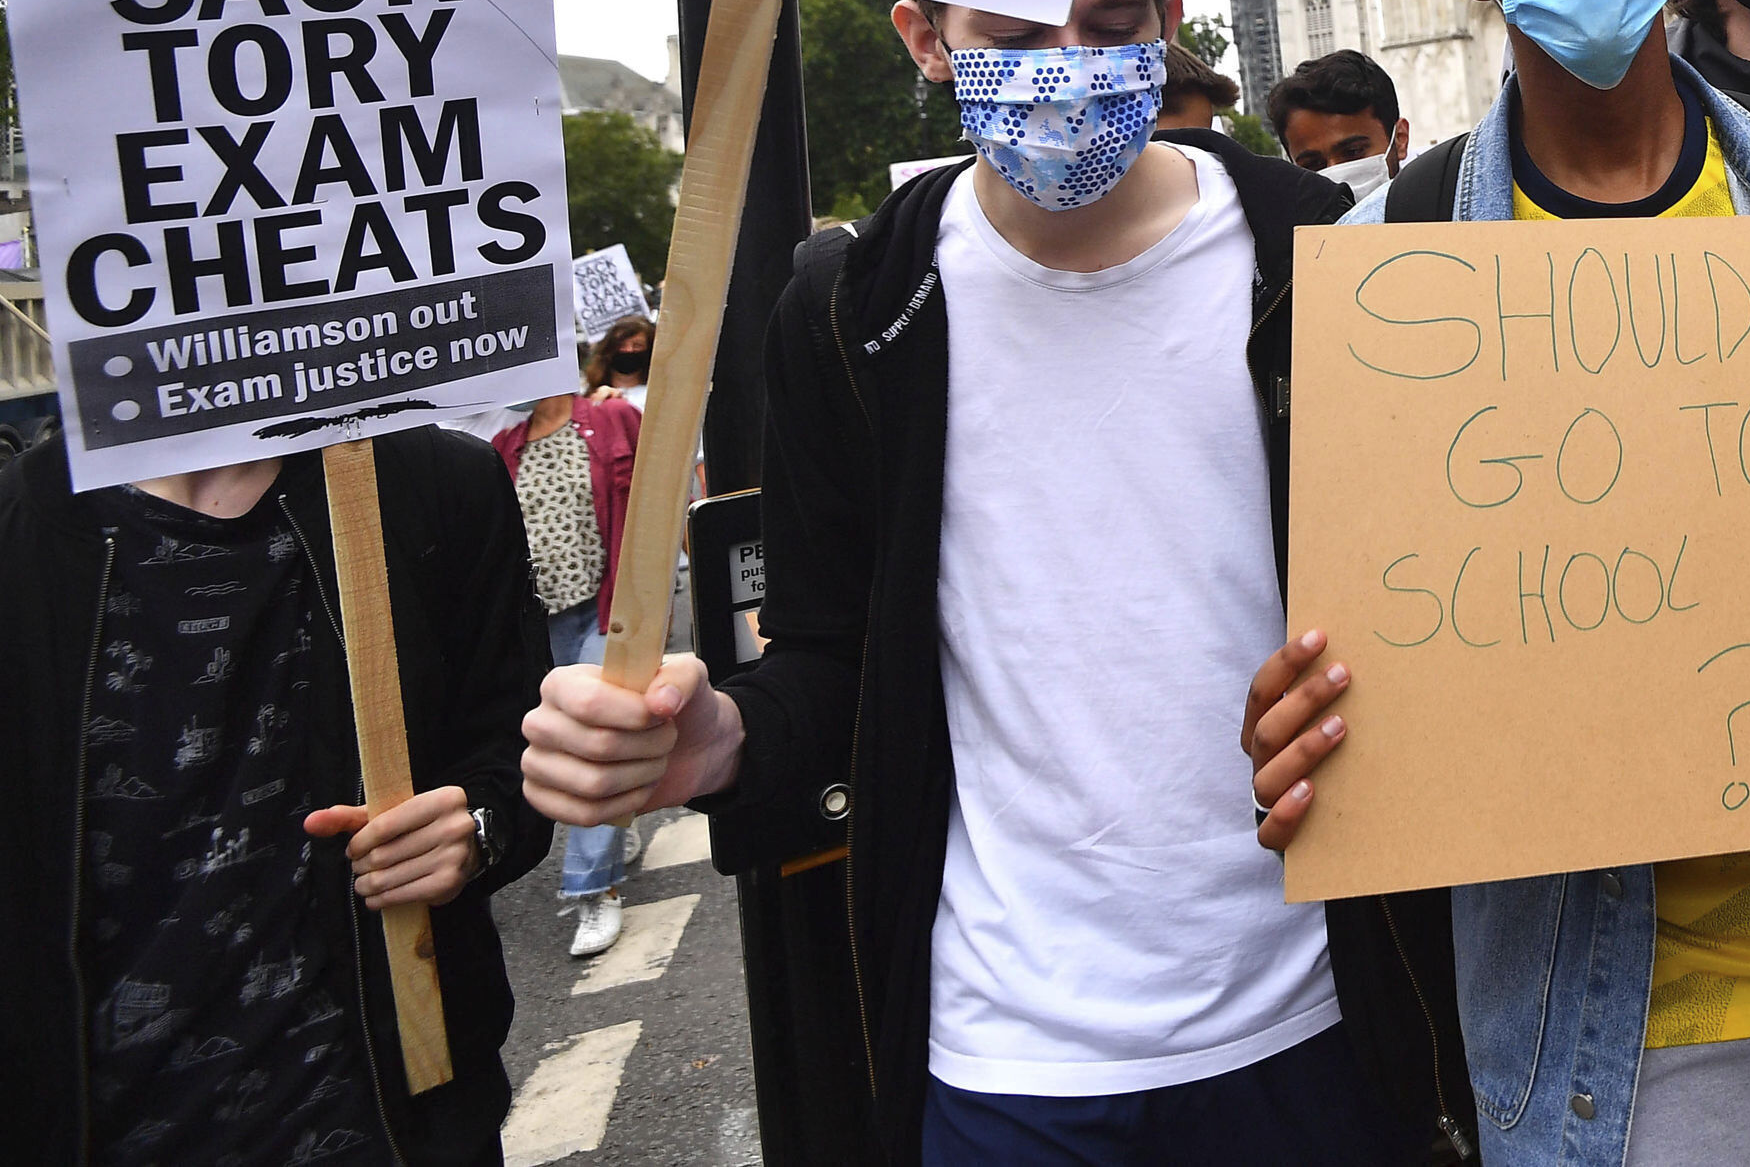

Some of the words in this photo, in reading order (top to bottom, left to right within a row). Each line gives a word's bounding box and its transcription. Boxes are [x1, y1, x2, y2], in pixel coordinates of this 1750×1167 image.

[122, 8, 457, 122] TORY
[116, 97, 484, 224] EXAM
[66, 180, 548, 328] CHEATS
[882, 314, 910, 342] SUPPLY
[908, 272, 937, 310] DEMAND
[147, 311, 397, 373] Williamson
[409, 290, 477, 325] out
[157, 370, 282, 419] Exam
[294, 344, 438, 402] justice
[450, 324, 529, 361] now
[1446, 405, 1624, 508] GO
[1374, 535, 1700, 648] SCHOOL
